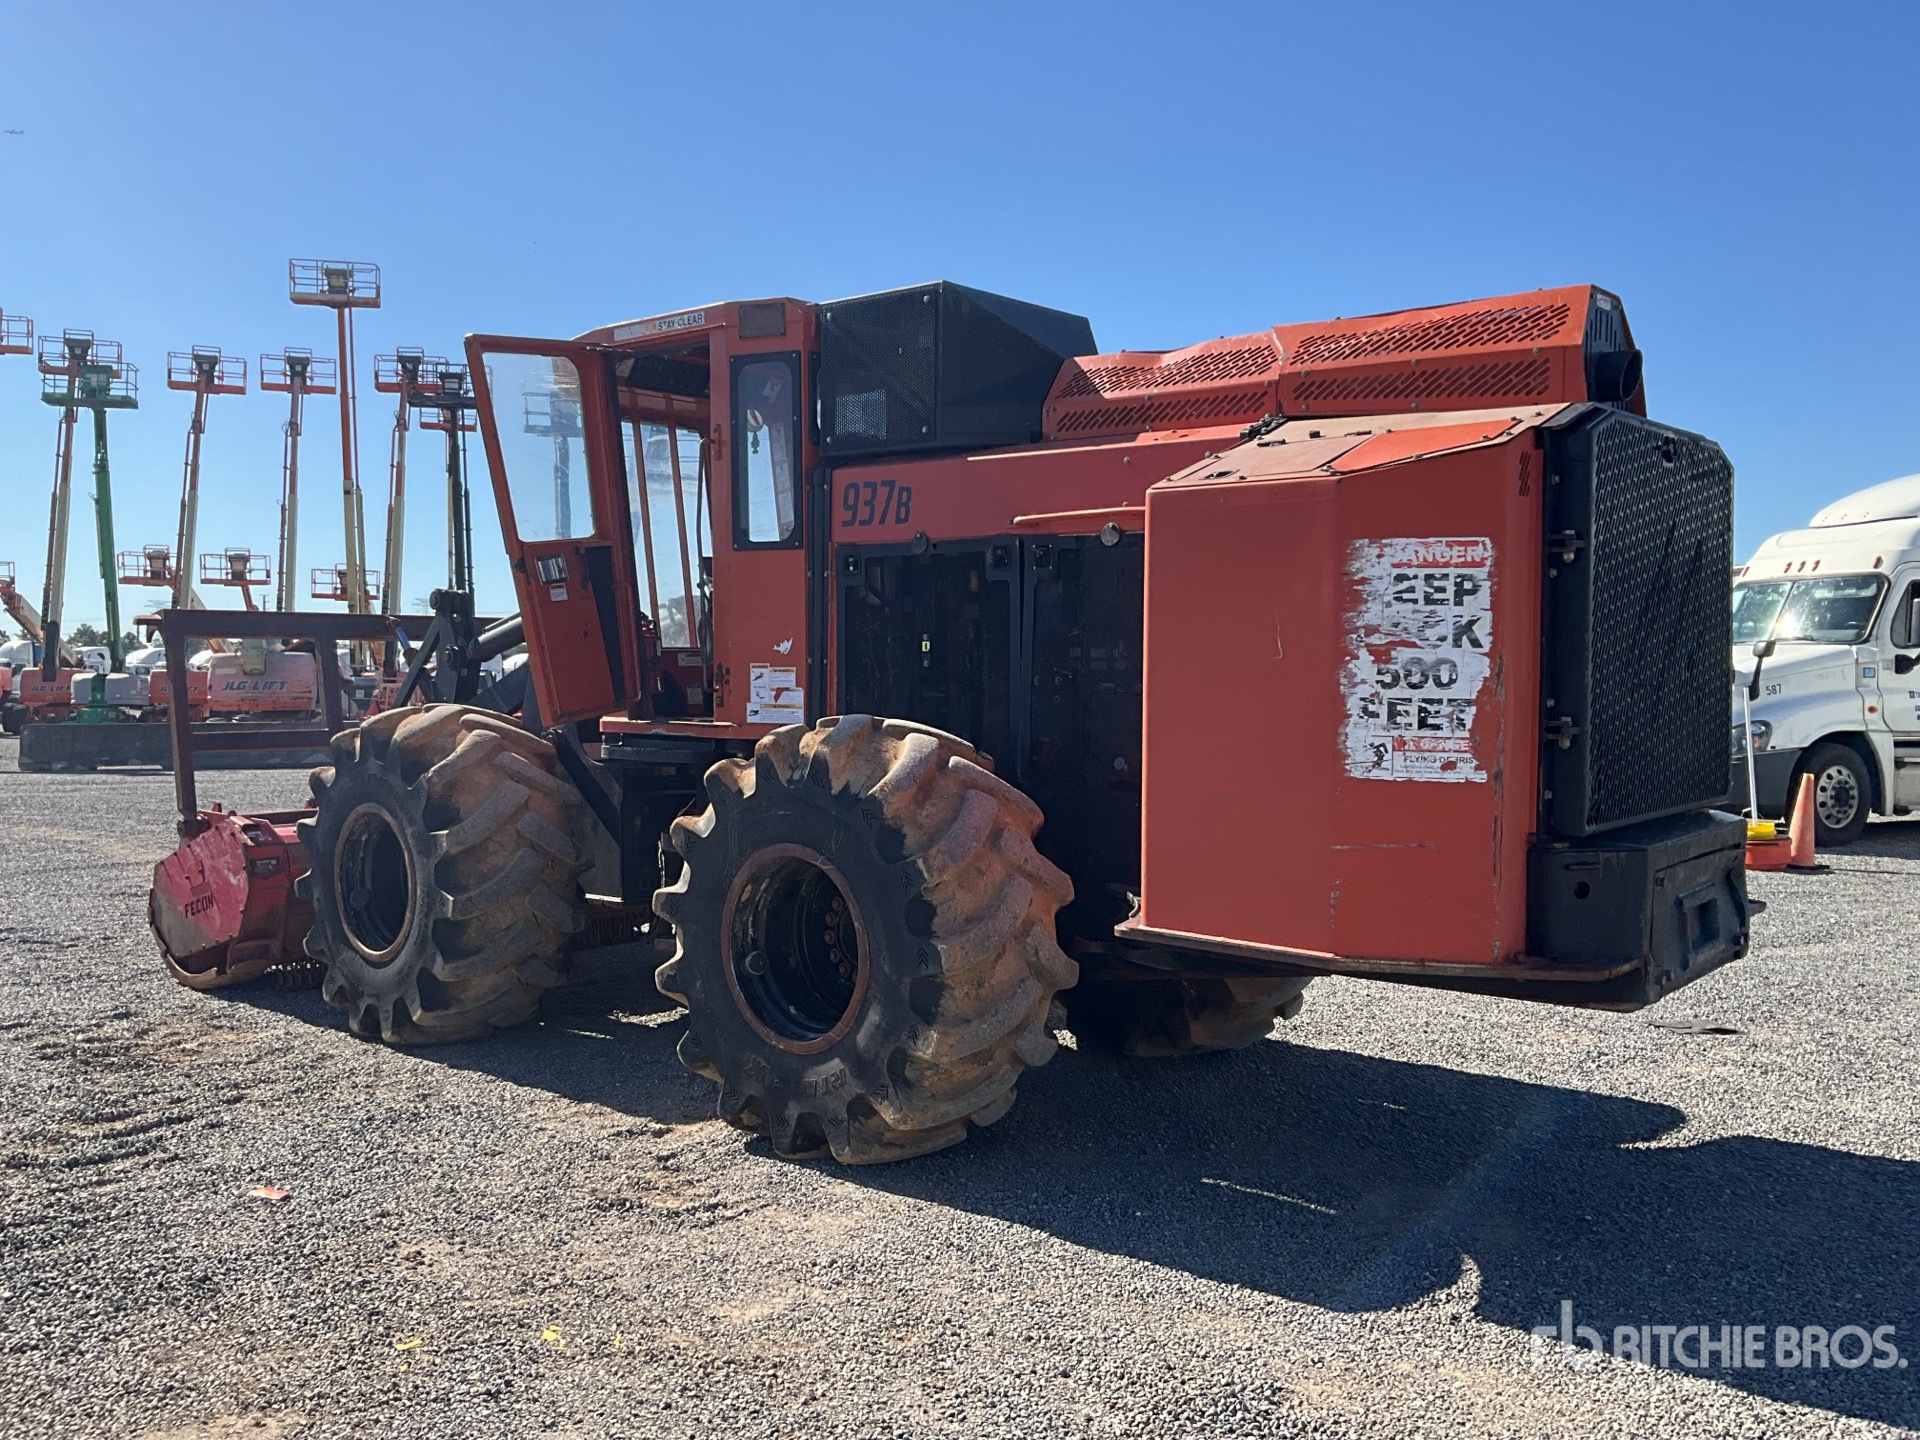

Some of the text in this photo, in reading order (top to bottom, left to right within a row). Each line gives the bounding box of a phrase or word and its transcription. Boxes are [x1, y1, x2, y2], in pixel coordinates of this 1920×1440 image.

[657, 313, 703, 331] STAY CLEAR
[841, 479, 912, 528] 937B
[1397, 545, 1483, 562] ANGER
[222, 681, 289, 691] JLG LIFT
[1765, 683, 1782, 696] 587
[184, 892, 214, 919] FECON
